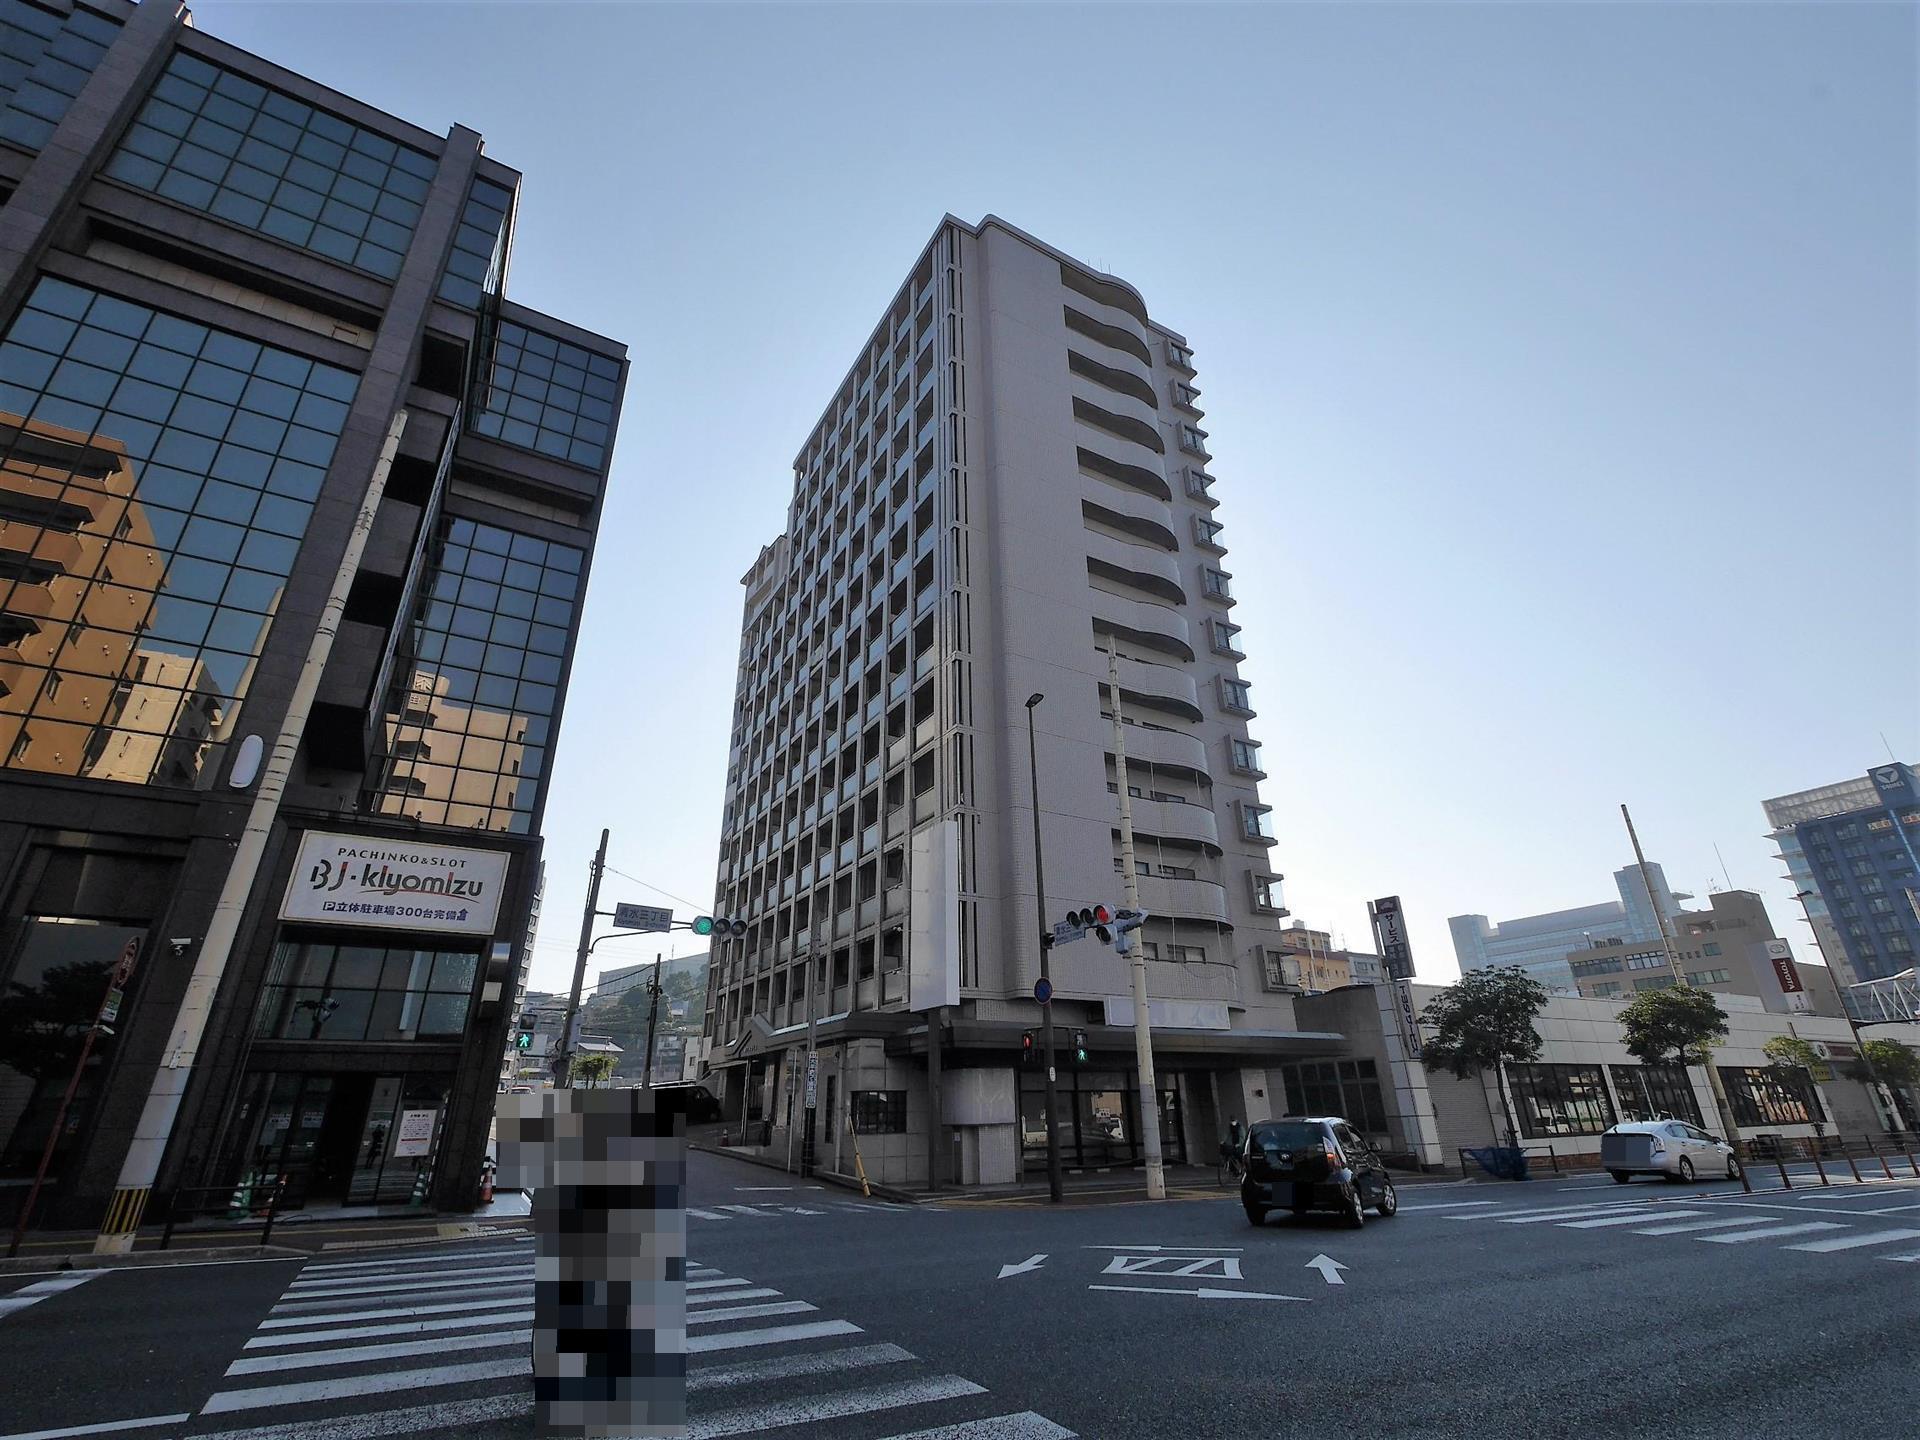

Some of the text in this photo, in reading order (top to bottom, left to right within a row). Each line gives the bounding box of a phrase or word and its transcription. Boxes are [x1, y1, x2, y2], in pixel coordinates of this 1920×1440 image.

[338, 848, 467, 868] PACHINKO&SLOT
[1385, 913, 1399, 944] サービス
[1780, 960, 1795, 990] TOYOTA
